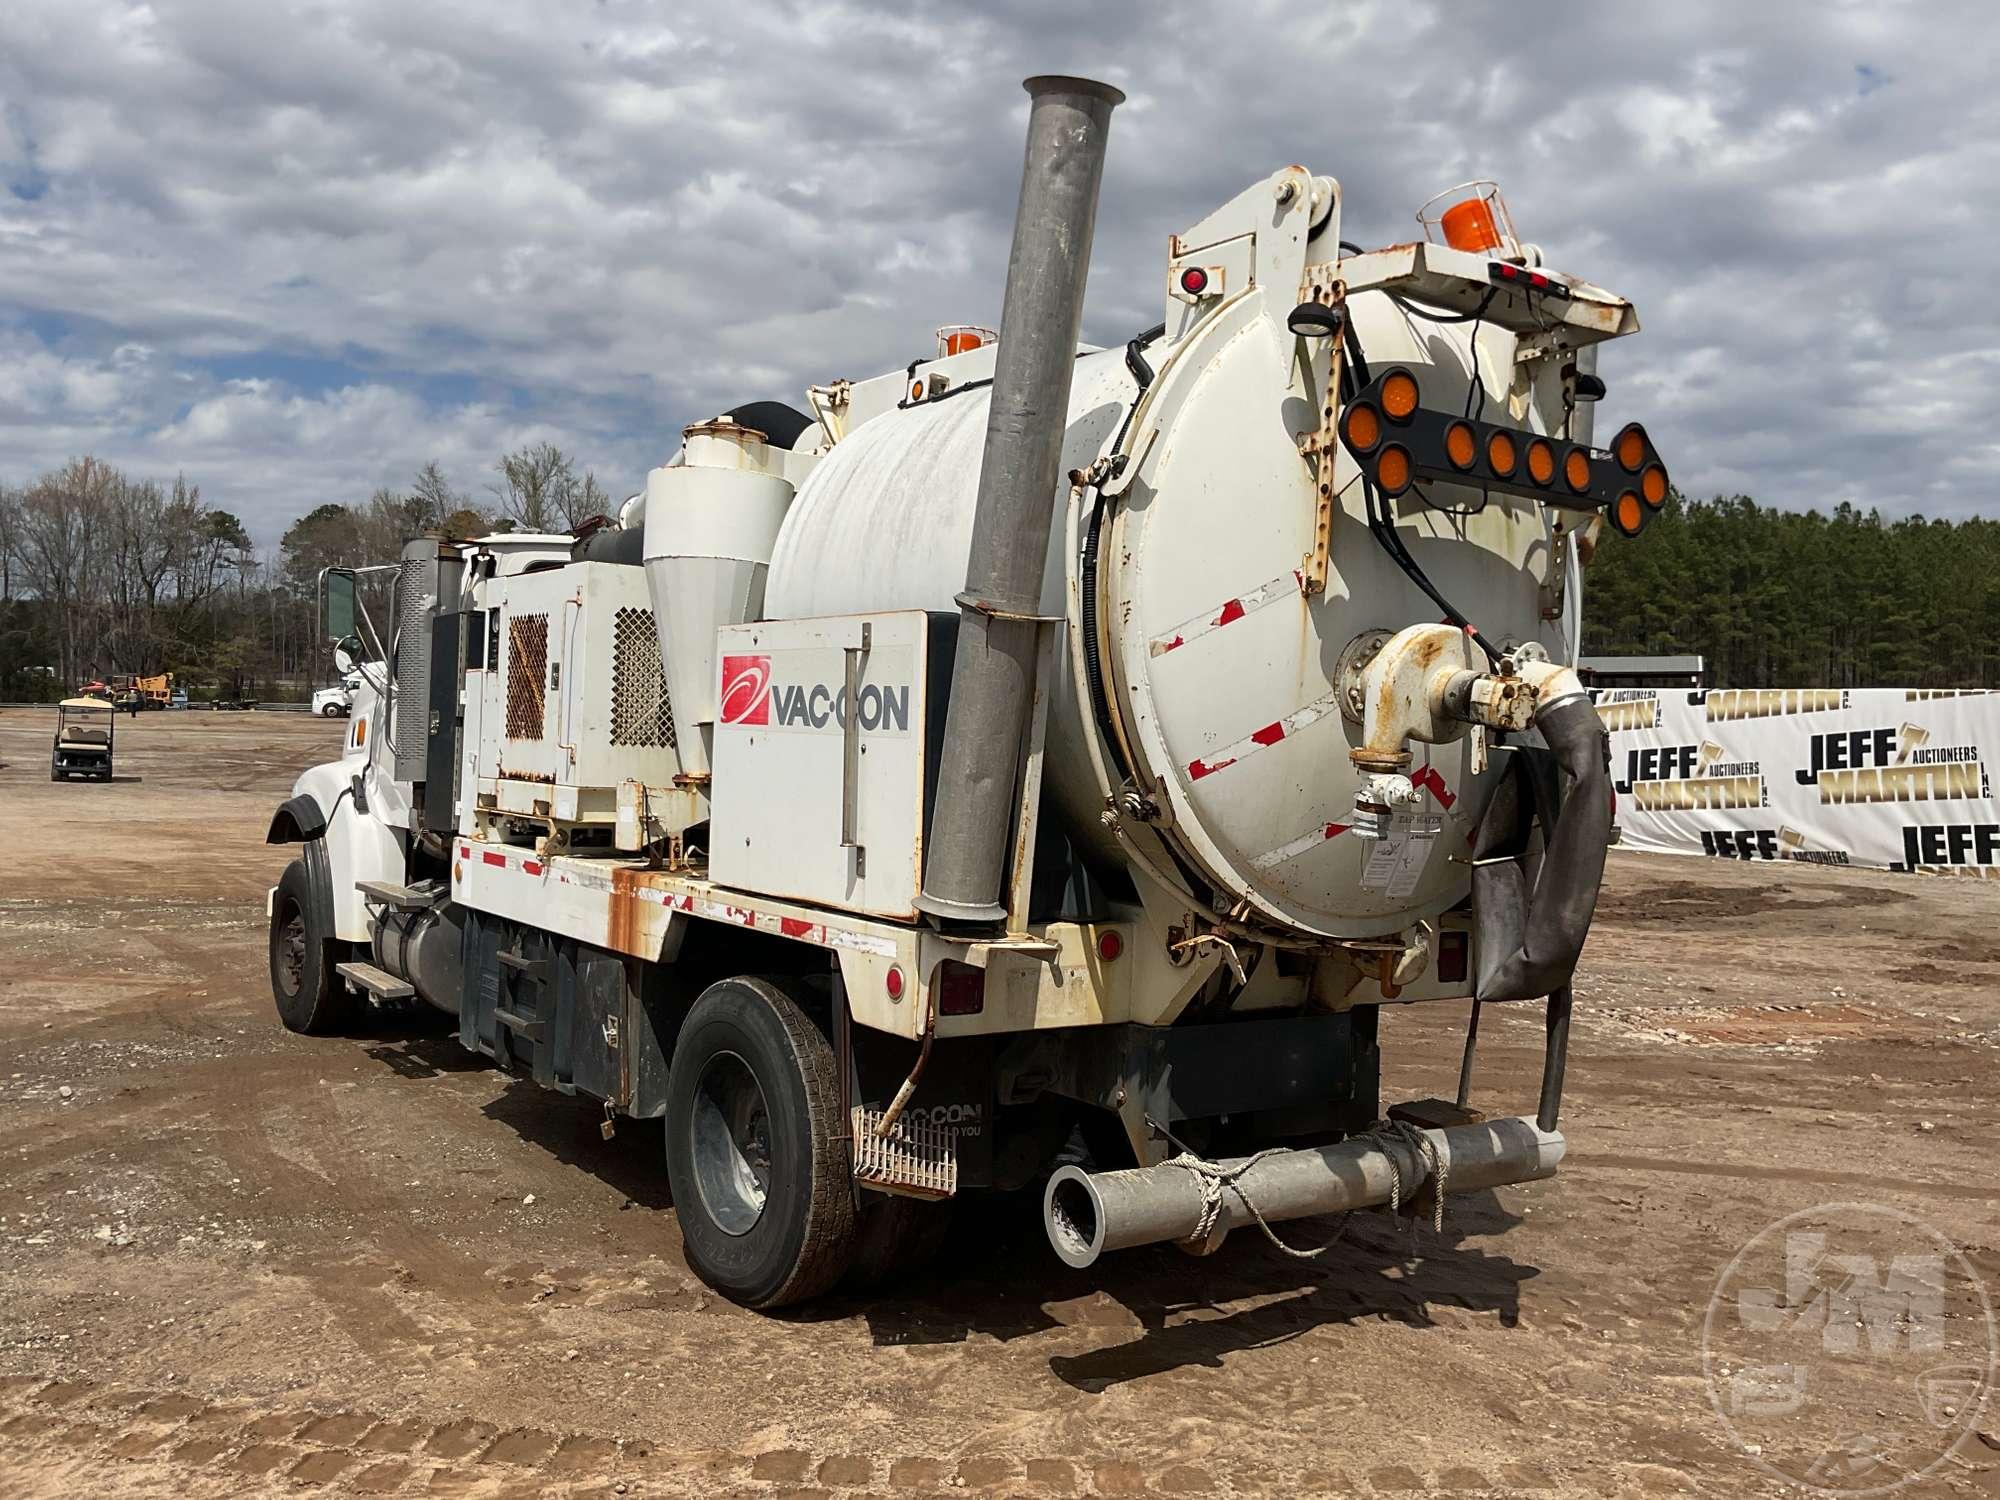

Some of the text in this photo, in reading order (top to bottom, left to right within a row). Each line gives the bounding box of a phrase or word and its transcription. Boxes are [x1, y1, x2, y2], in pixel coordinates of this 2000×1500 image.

[1706, 689, 1841, 723] MARTIN
[1615, 746, 1697, 794] JEFF
[1709, 762, 1760, 777] AUCTIONEERS
[1795, 728, 1897, 785] JEFF
[1912, 747, 1977, 764] AUCTIONEERS
[1633, 776, 1760, 811] MARTIN
[1819, 763, 1979, 805] MARTIN
[1890, 825, 2000, 875] JEFF
